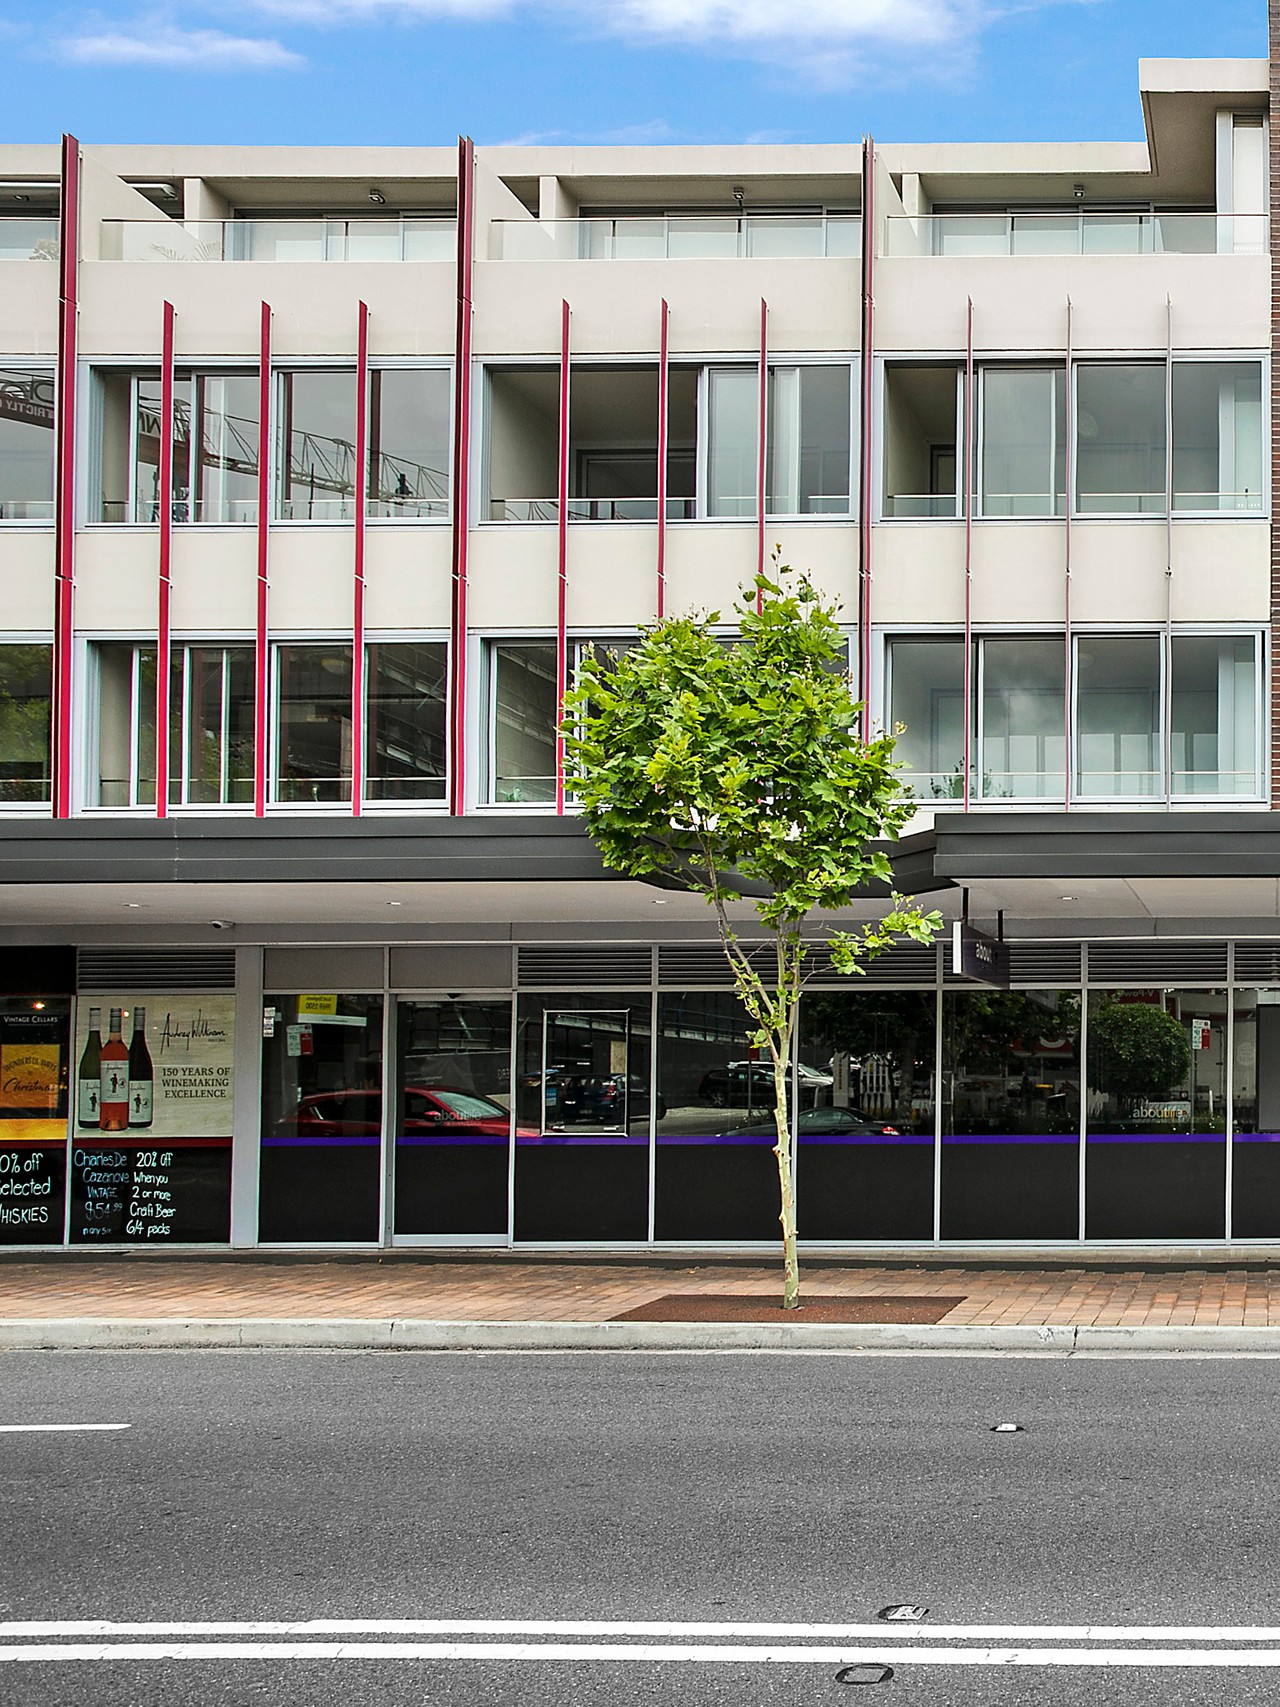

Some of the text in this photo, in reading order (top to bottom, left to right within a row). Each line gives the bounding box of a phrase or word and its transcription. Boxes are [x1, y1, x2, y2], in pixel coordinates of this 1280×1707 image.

[3, 1015, 58, 1023] VINTAGE CELLARS
[162, 1067, 231, 1077] 150 YEARS OF
[3, 1077, 55, 1094] Christmas
[161, 1078, 229, 1087] WINEMAKING
[165, 1089, 227, 1099] EXCELLENCE
[24, 1153, 43, 1172] off
[136, 1151, 157, 1167] 20%
[0, 1176, 51, 1196] elected
[87, 1186, 118, 1198] VINTAGE
[132, 1186, 172, 1201] 2 or more
[0, 1203, 49, 1224] HISKIES
[129, 1201, 177, 1218] Craft Beer
[147, 1224, 171, 1238] packs
